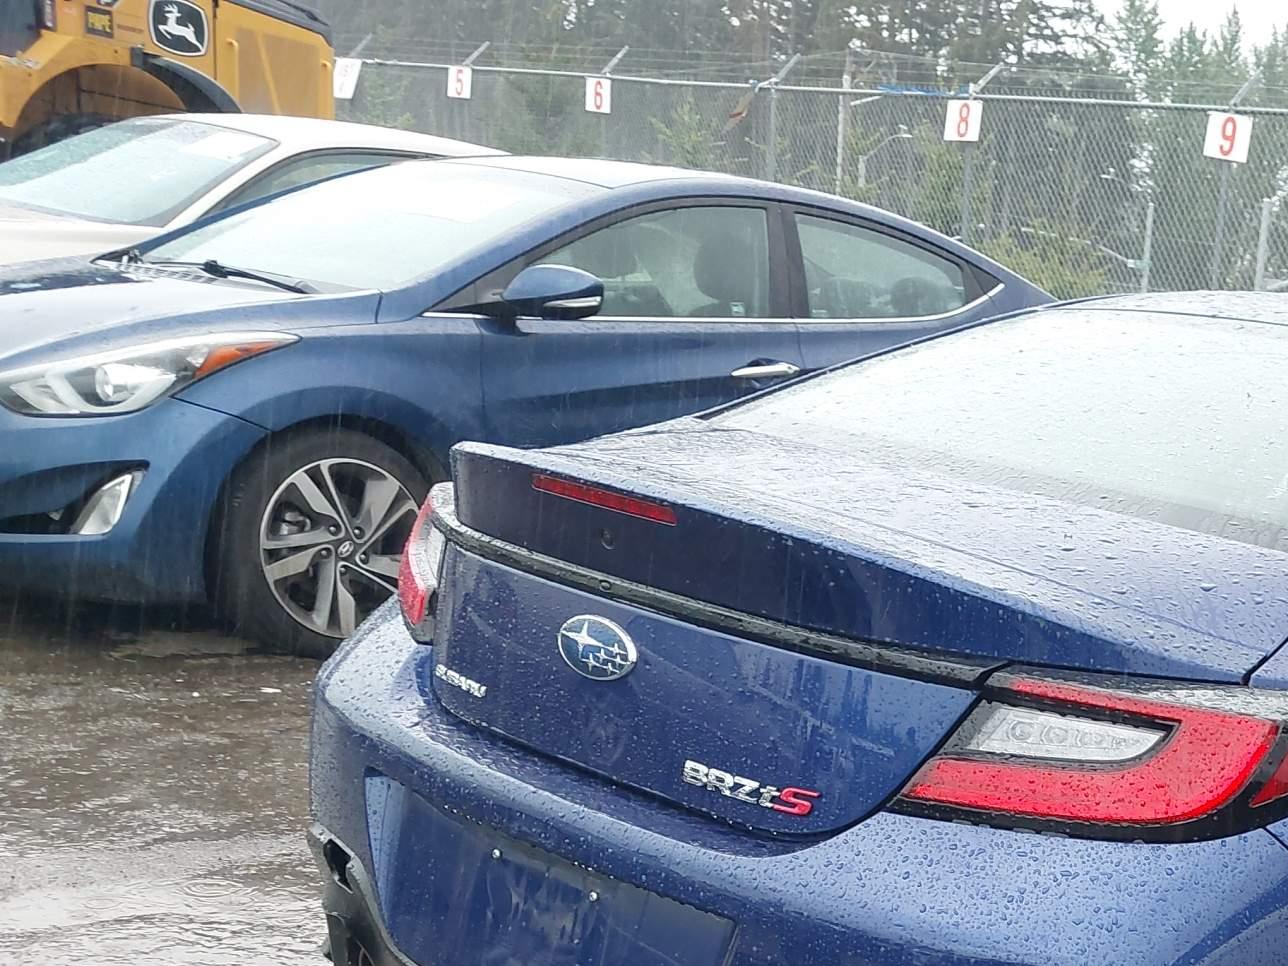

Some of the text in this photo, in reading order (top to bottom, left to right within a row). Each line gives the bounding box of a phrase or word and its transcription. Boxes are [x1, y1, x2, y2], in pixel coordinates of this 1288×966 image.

[455, 69, 464, 97] 5
[594, 80, 604, 111] 6
[957, 102, 970, 138] 8
[1219, 116, 1237, 156] 9
